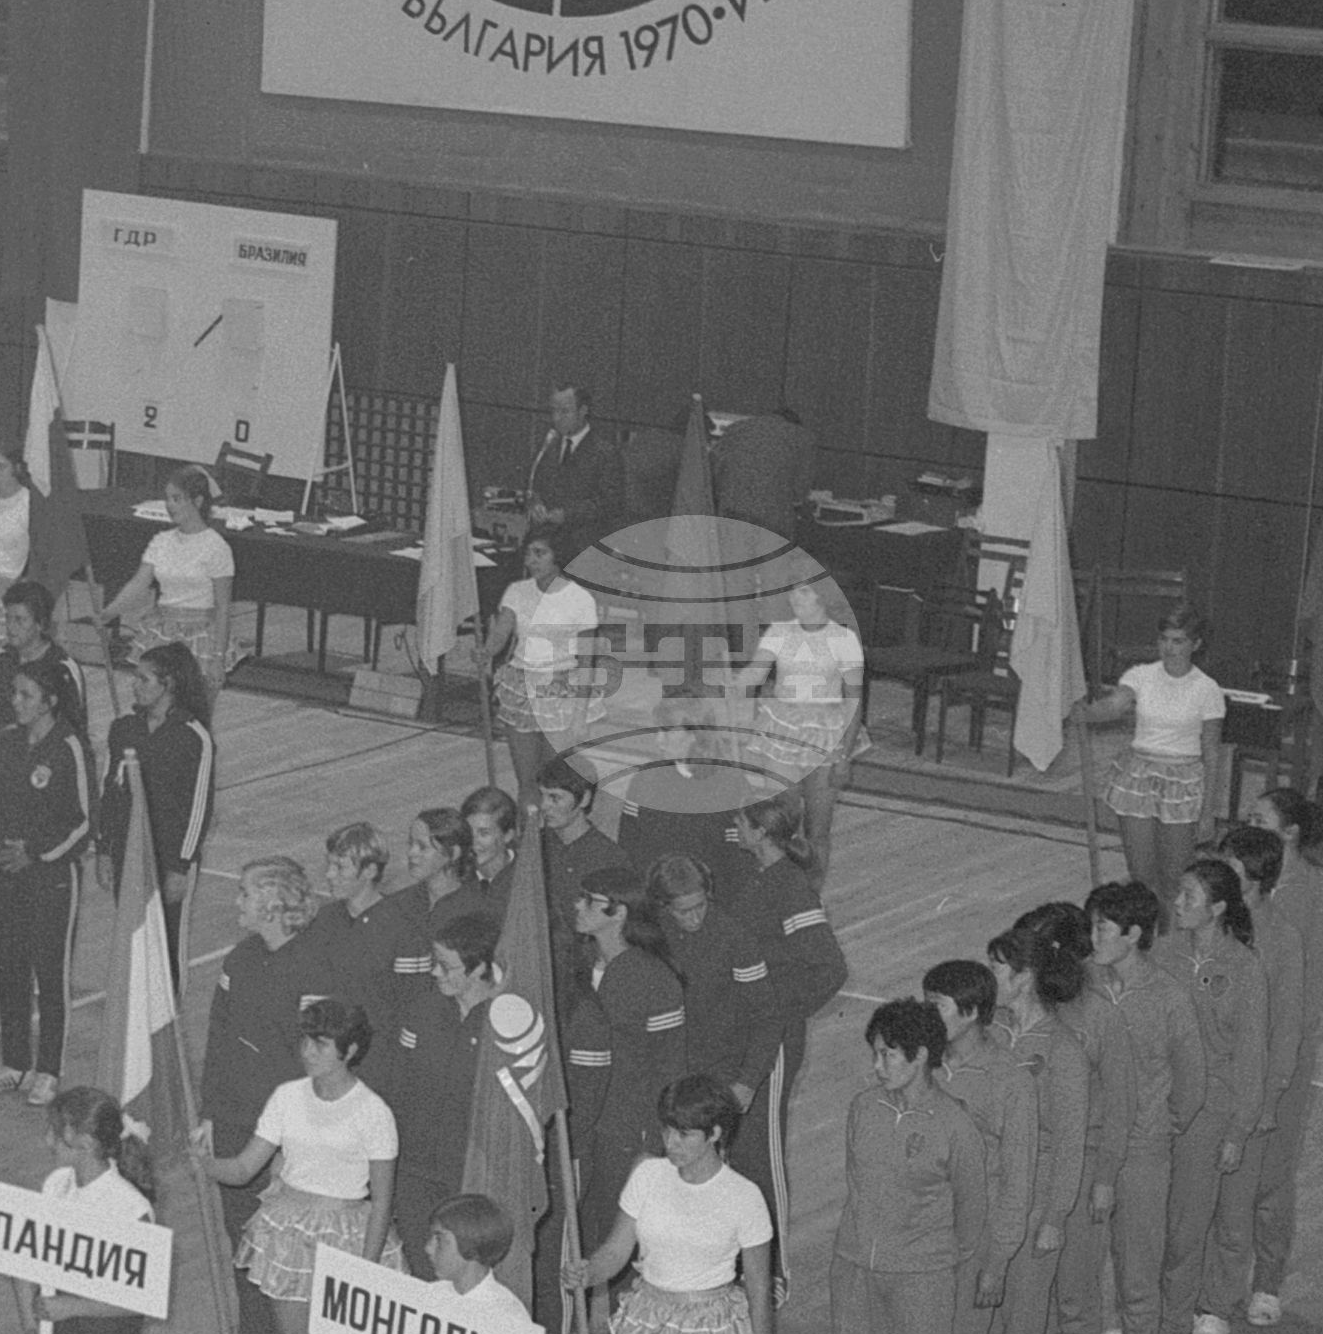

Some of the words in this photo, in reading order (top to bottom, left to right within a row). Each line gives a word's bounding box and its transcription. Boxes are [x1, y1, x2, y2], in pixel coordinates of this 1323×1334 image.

[619, 2, 715, 71] 1970
[113, 228, 157, 247] ГДР
[237, 243, 308, 268] БРАЗИЛИЯ
